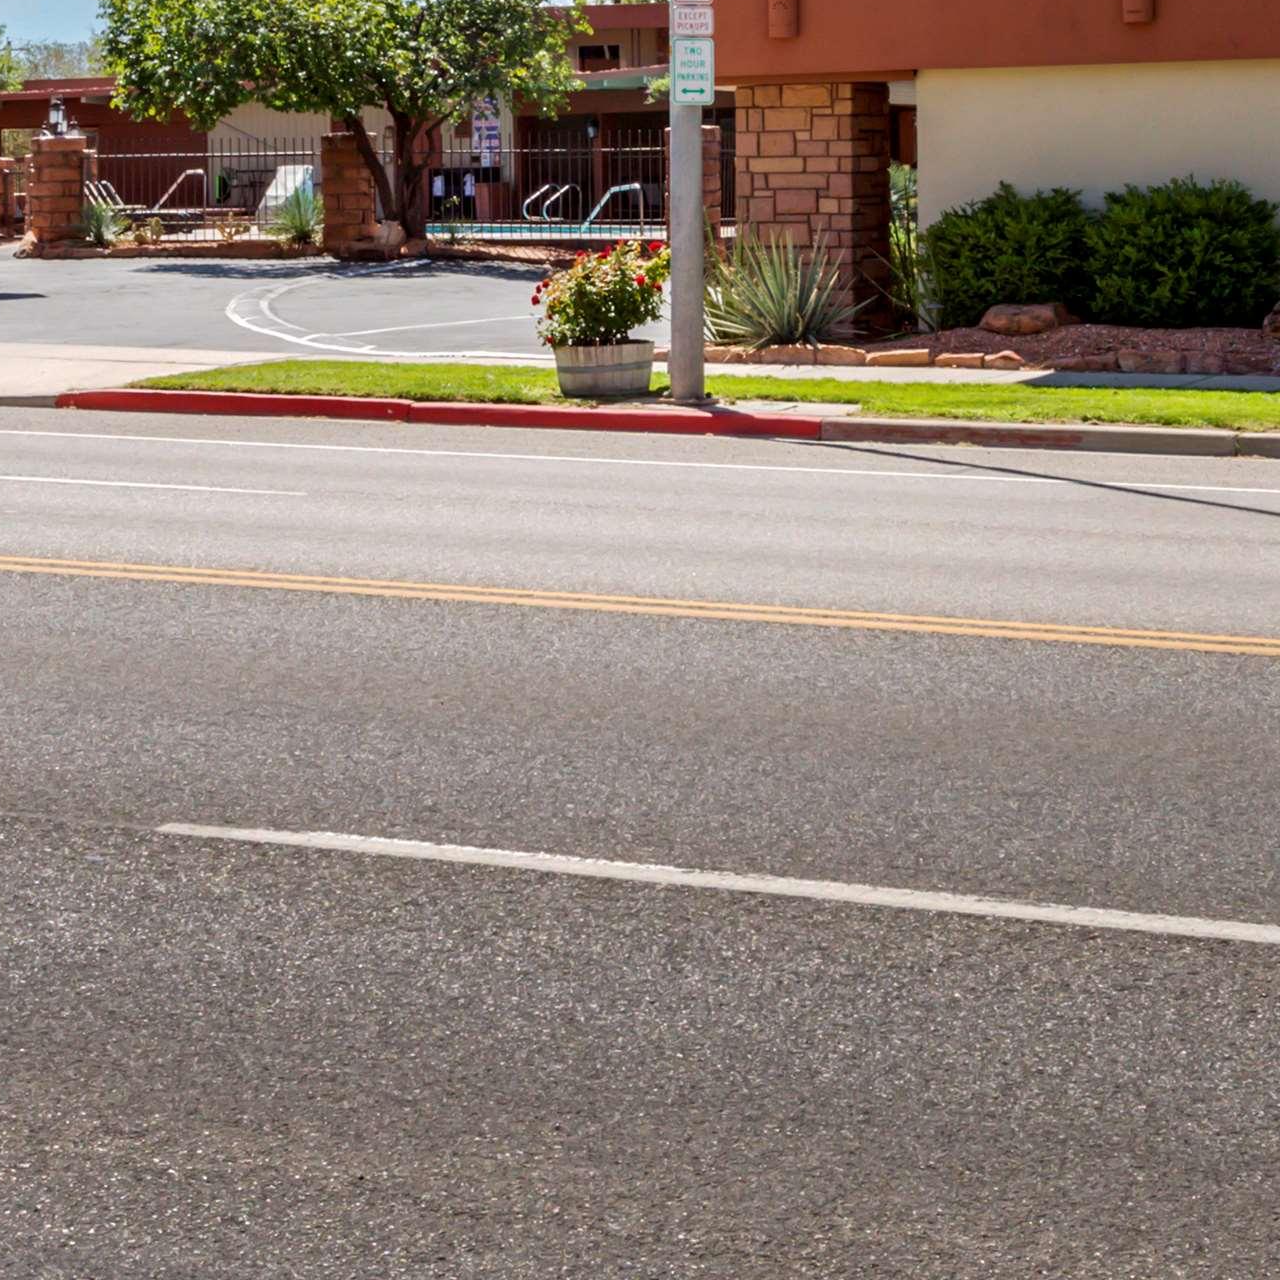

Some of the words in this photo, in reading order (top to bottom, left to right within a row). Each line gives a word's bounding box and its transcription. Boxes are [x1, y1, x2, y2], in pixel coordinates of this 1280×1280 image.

[678, 11, 707, 19] EXCEPT
[677, 22, 709, 31] PICKUPS
[684, 47, 702, 55] TWO
[680, 60, 705, 68] HOUR
[677, 73, 709, 81] PARKING
